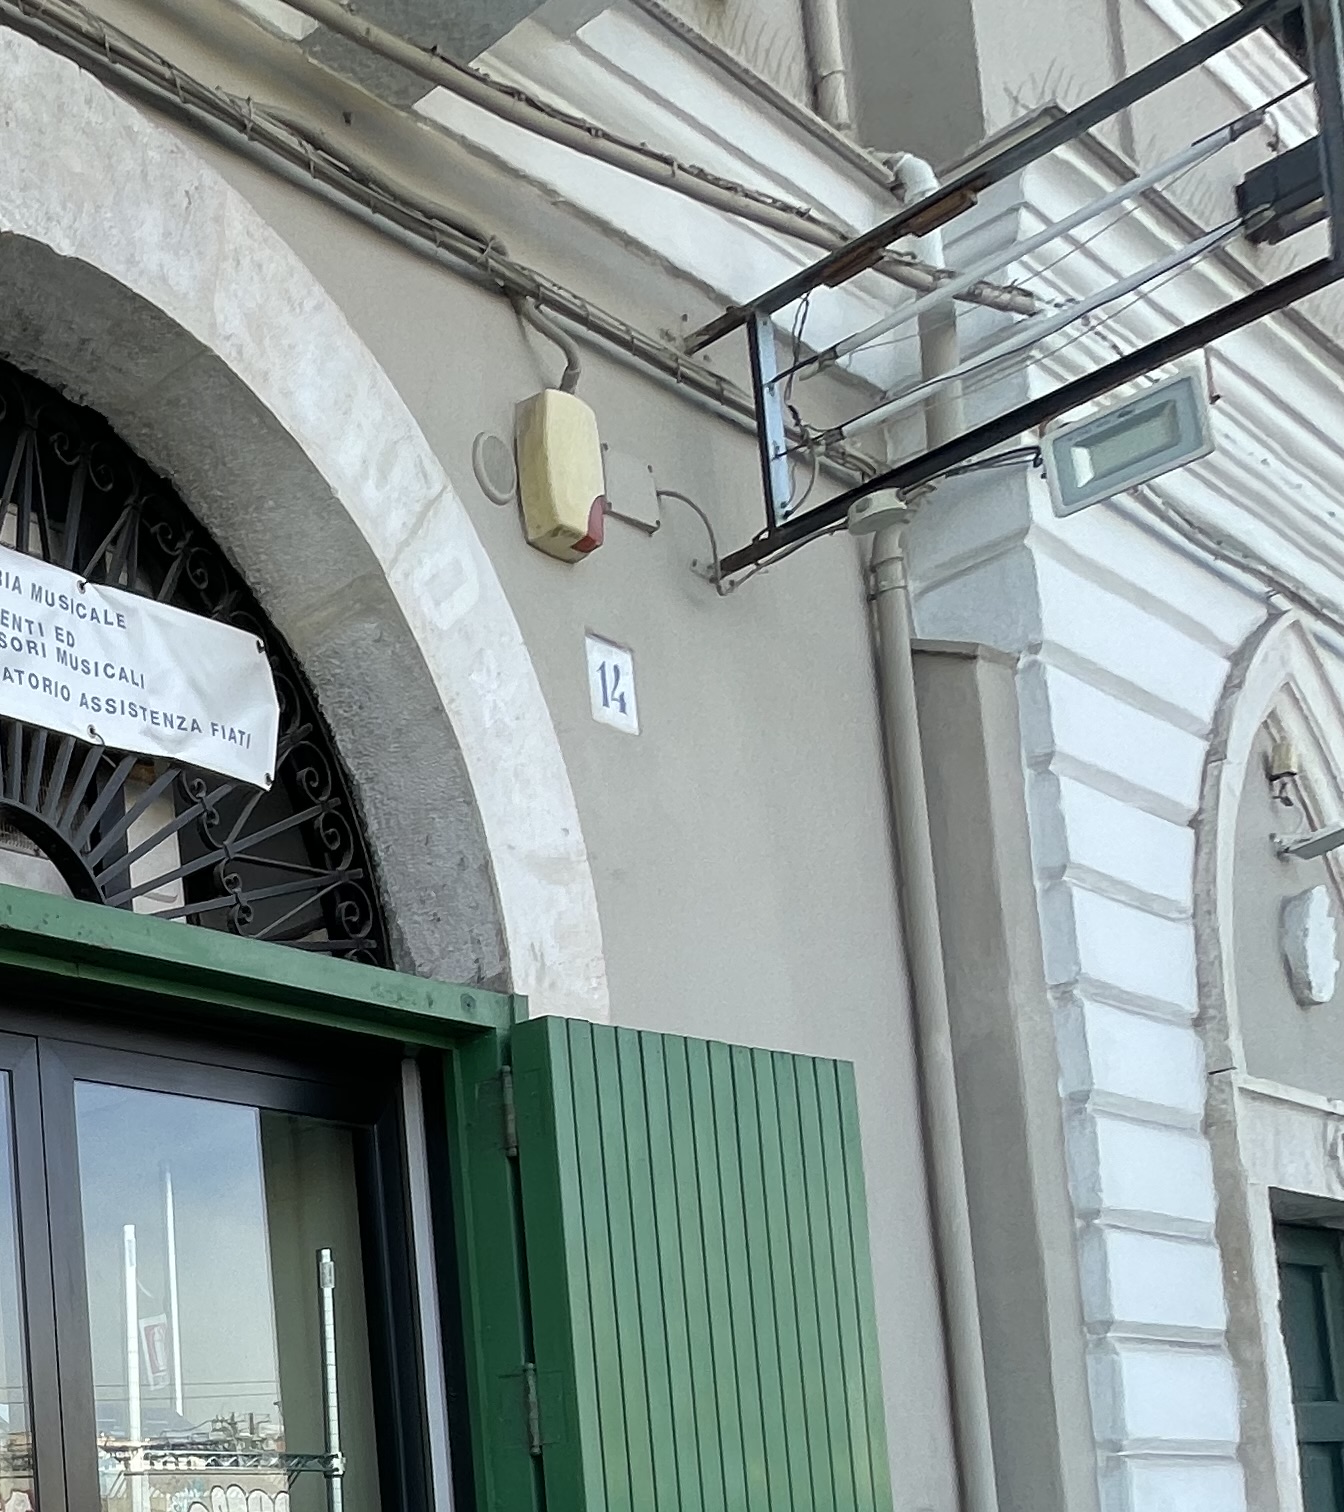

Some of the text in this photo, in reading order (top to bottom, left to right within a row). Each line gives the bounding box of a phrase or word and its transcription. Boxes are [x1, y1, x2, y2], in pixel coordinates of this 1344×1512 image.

[30, 582, 127, 629] MUSICALE
[54, 625, 75, 648] ED
[55, 646, 145, 690] MUSICALI
[596, 660, 628, 716] 14
[79, 692, 203, 733] ASSISTENZA
[211, 721, 252, 750] FIATI
